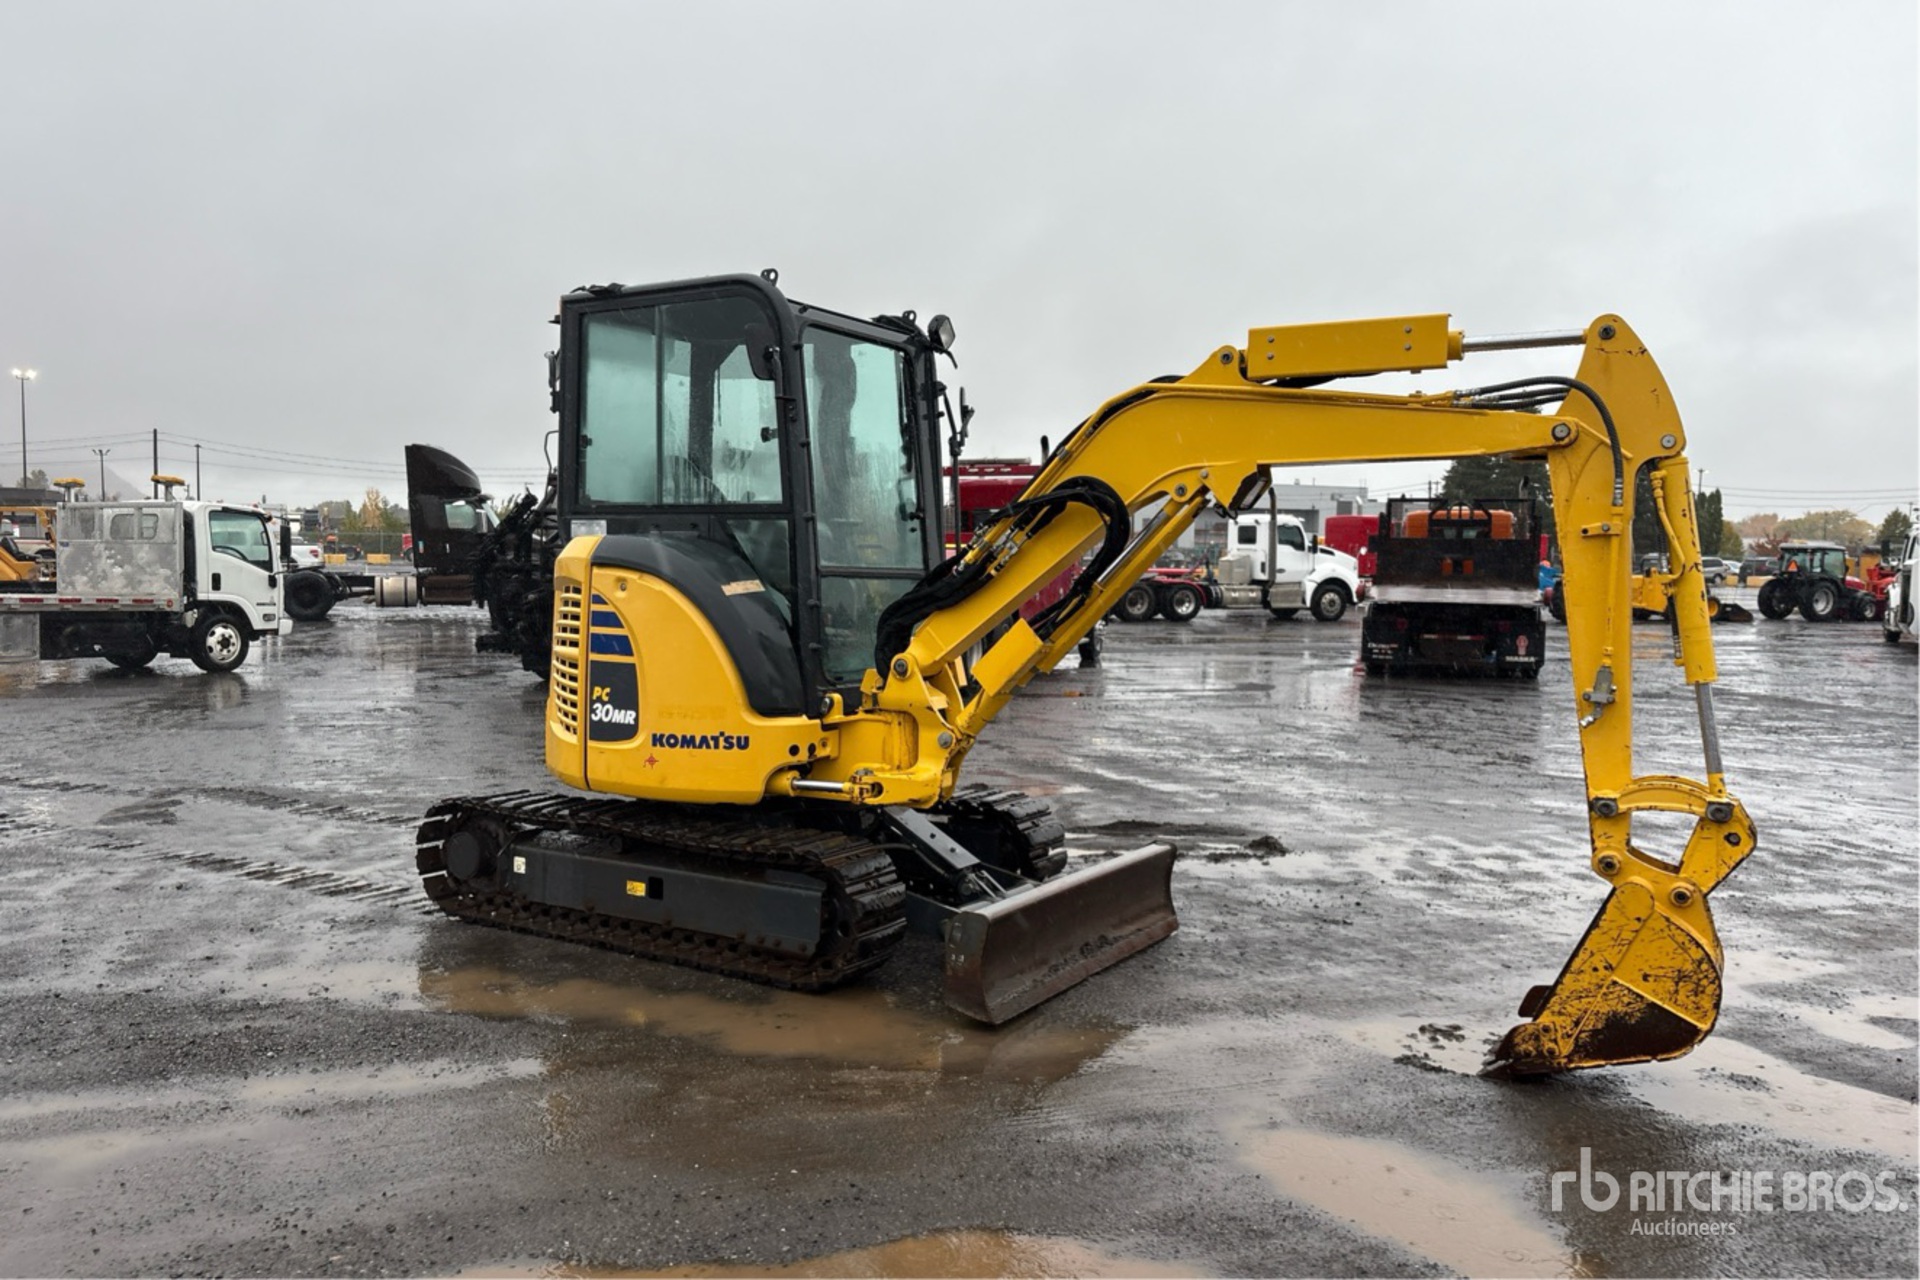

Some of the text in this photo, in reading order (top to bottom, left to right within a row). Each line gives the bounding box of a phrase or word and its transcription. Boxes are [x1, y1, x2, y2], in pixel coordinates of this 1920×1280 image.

[592, 686, 611, 701] PC
[591, 702, 637, 725] 30MR
[651, 731, 750, 750] KOMATSU
